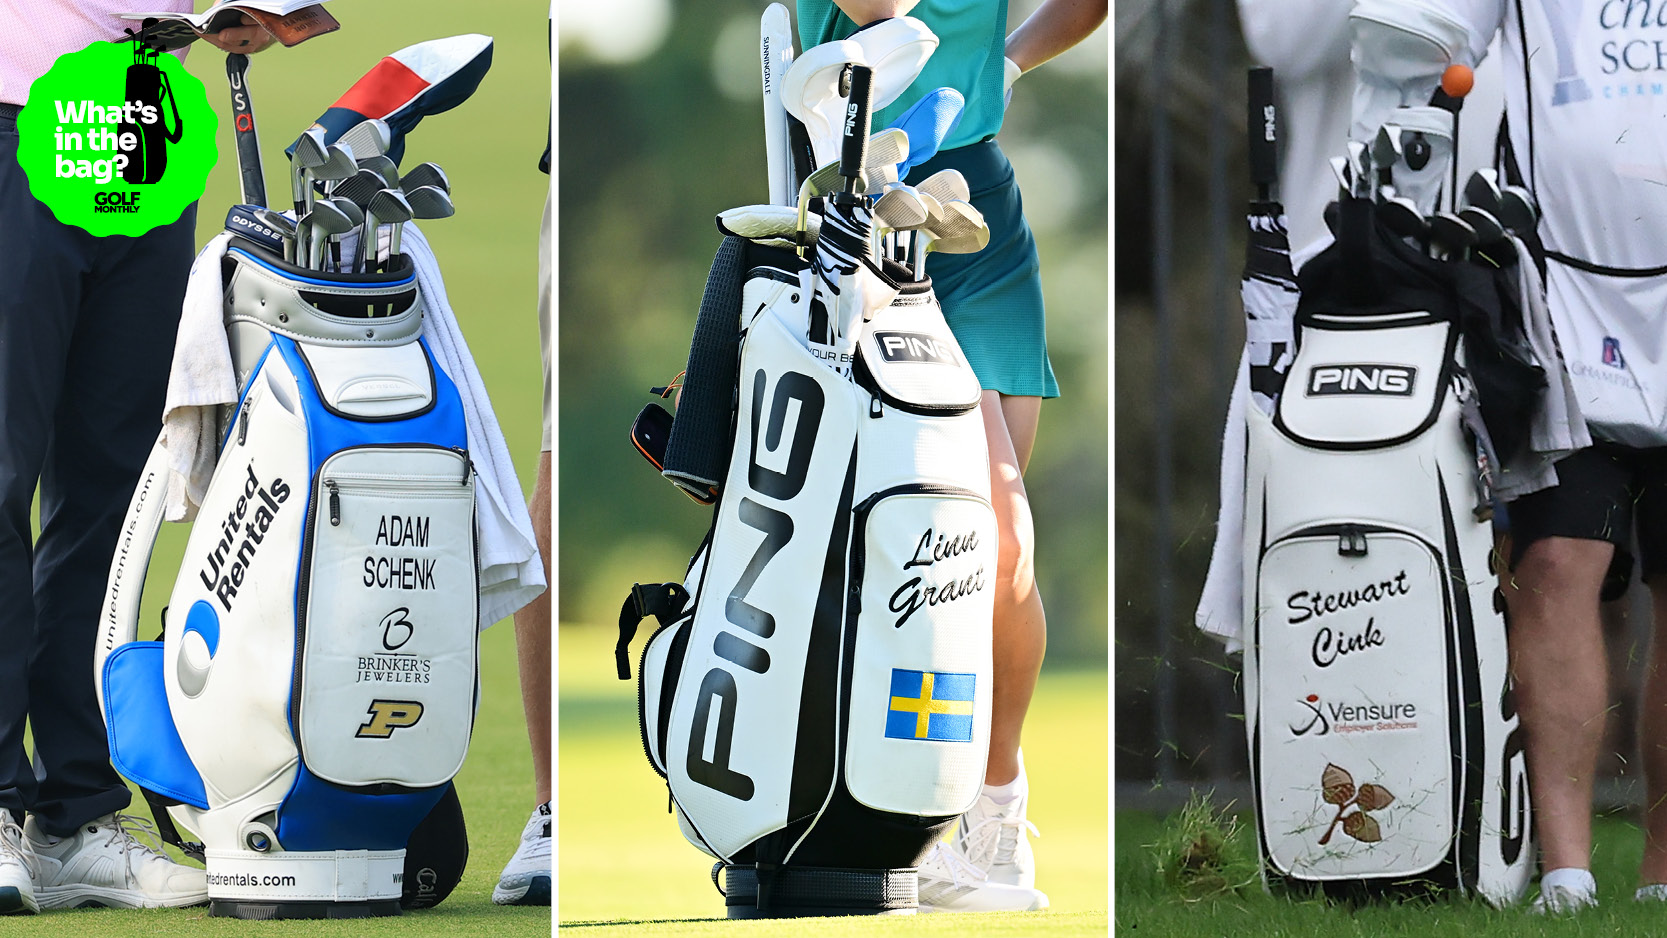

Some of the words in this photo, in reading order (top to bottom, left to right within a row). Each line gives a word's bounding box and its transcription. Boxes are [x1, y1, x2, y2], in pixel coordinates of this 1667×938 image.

[763, 36, 771, 95] SUNNINGDALE
[845, 103, 858, 137] PING
[1264, 105, 1275, 141] PING
[232, 215, 284, 243] ODYSSE
[883, 336, 952, 360] PING
[1312, 367, 1408, 392] PING
[200, 464, 259, 592] United
[216, 477, 291, 613] Rentals
[376, 515, 430, 547] ADAM
[105, 472, 155, 651] unitedrentals.com
[903, 528, 979, 571] Linn
[363, 556, 436, 590] SCHENK
[686, 369, 825, 801] PING
[888, 563, 985, 629] Grant
[1287, 569, 1410, 624] Stewart
[379, 607, 414, 651] B
[1312, 617, 1385, 668] Cink
[356, 671, 430, 684] JEWELERS
[358, 657, 431, 673] BRINKER'S
[355, 699, 425, 739] P
[1327, 702, 1416, 722] Vensure
